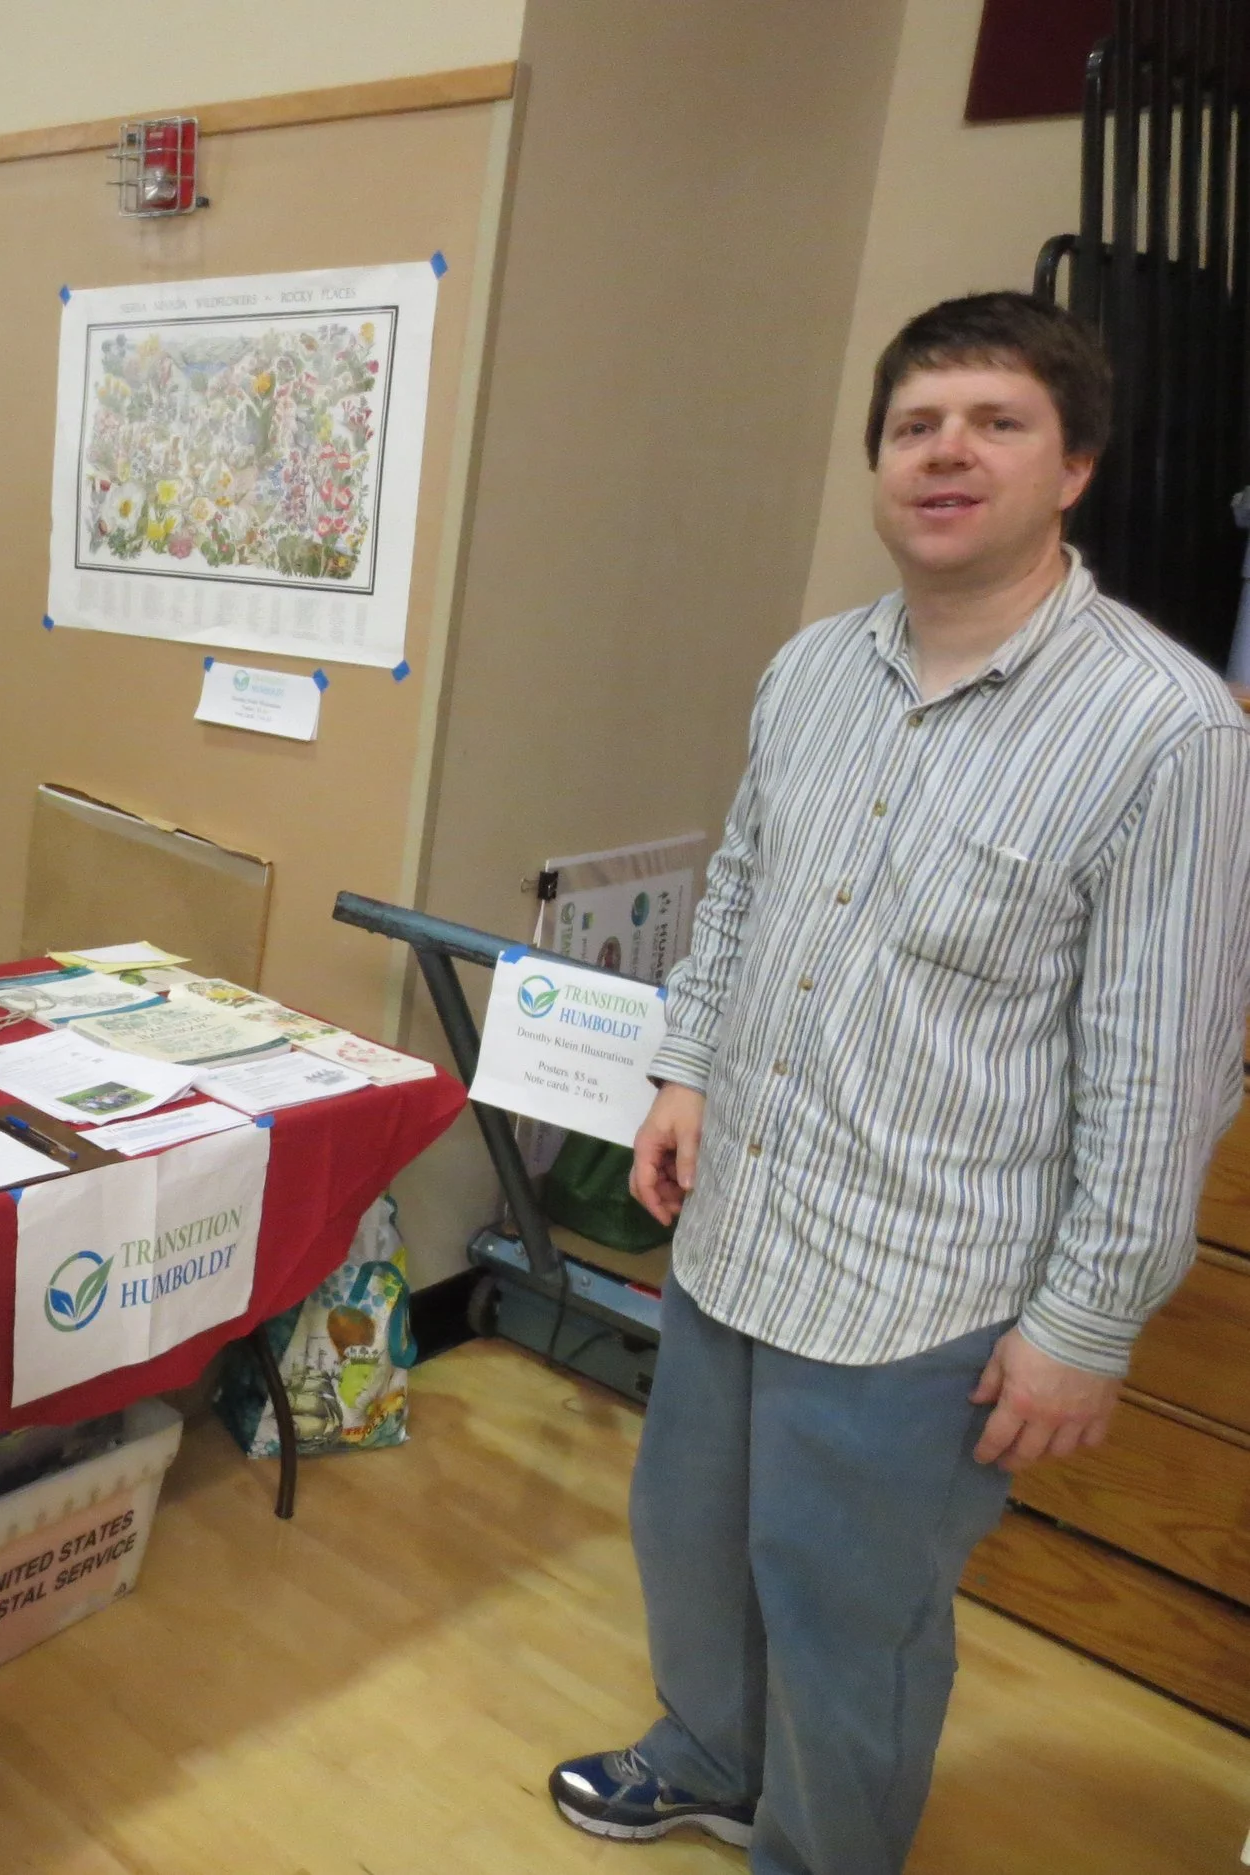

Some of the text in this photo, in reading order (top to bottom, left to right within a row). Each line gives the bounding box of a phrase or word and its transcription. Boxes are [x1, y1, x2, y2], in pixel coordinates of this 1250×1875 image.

[564, 984, 649, 1019] TRANSITION
[559, 1007, 642, 1042] HUMBOLDT
[516, 1026, 635, 1067] Dorothy Klein Illustrations
[524, 1071, 609, 1104] Note cards 2 for $1
[538, 1060, 569, 1077] Posters
[574, 1070, 585, 1082] $5
[121, 1205, 244, 1269] TRANSITION
[120, 1243, 237, 1309] HUMBOLDT
[58, 1509, 135, 1563] STATES
[54, 1532, 138, 1591] SERVICE
